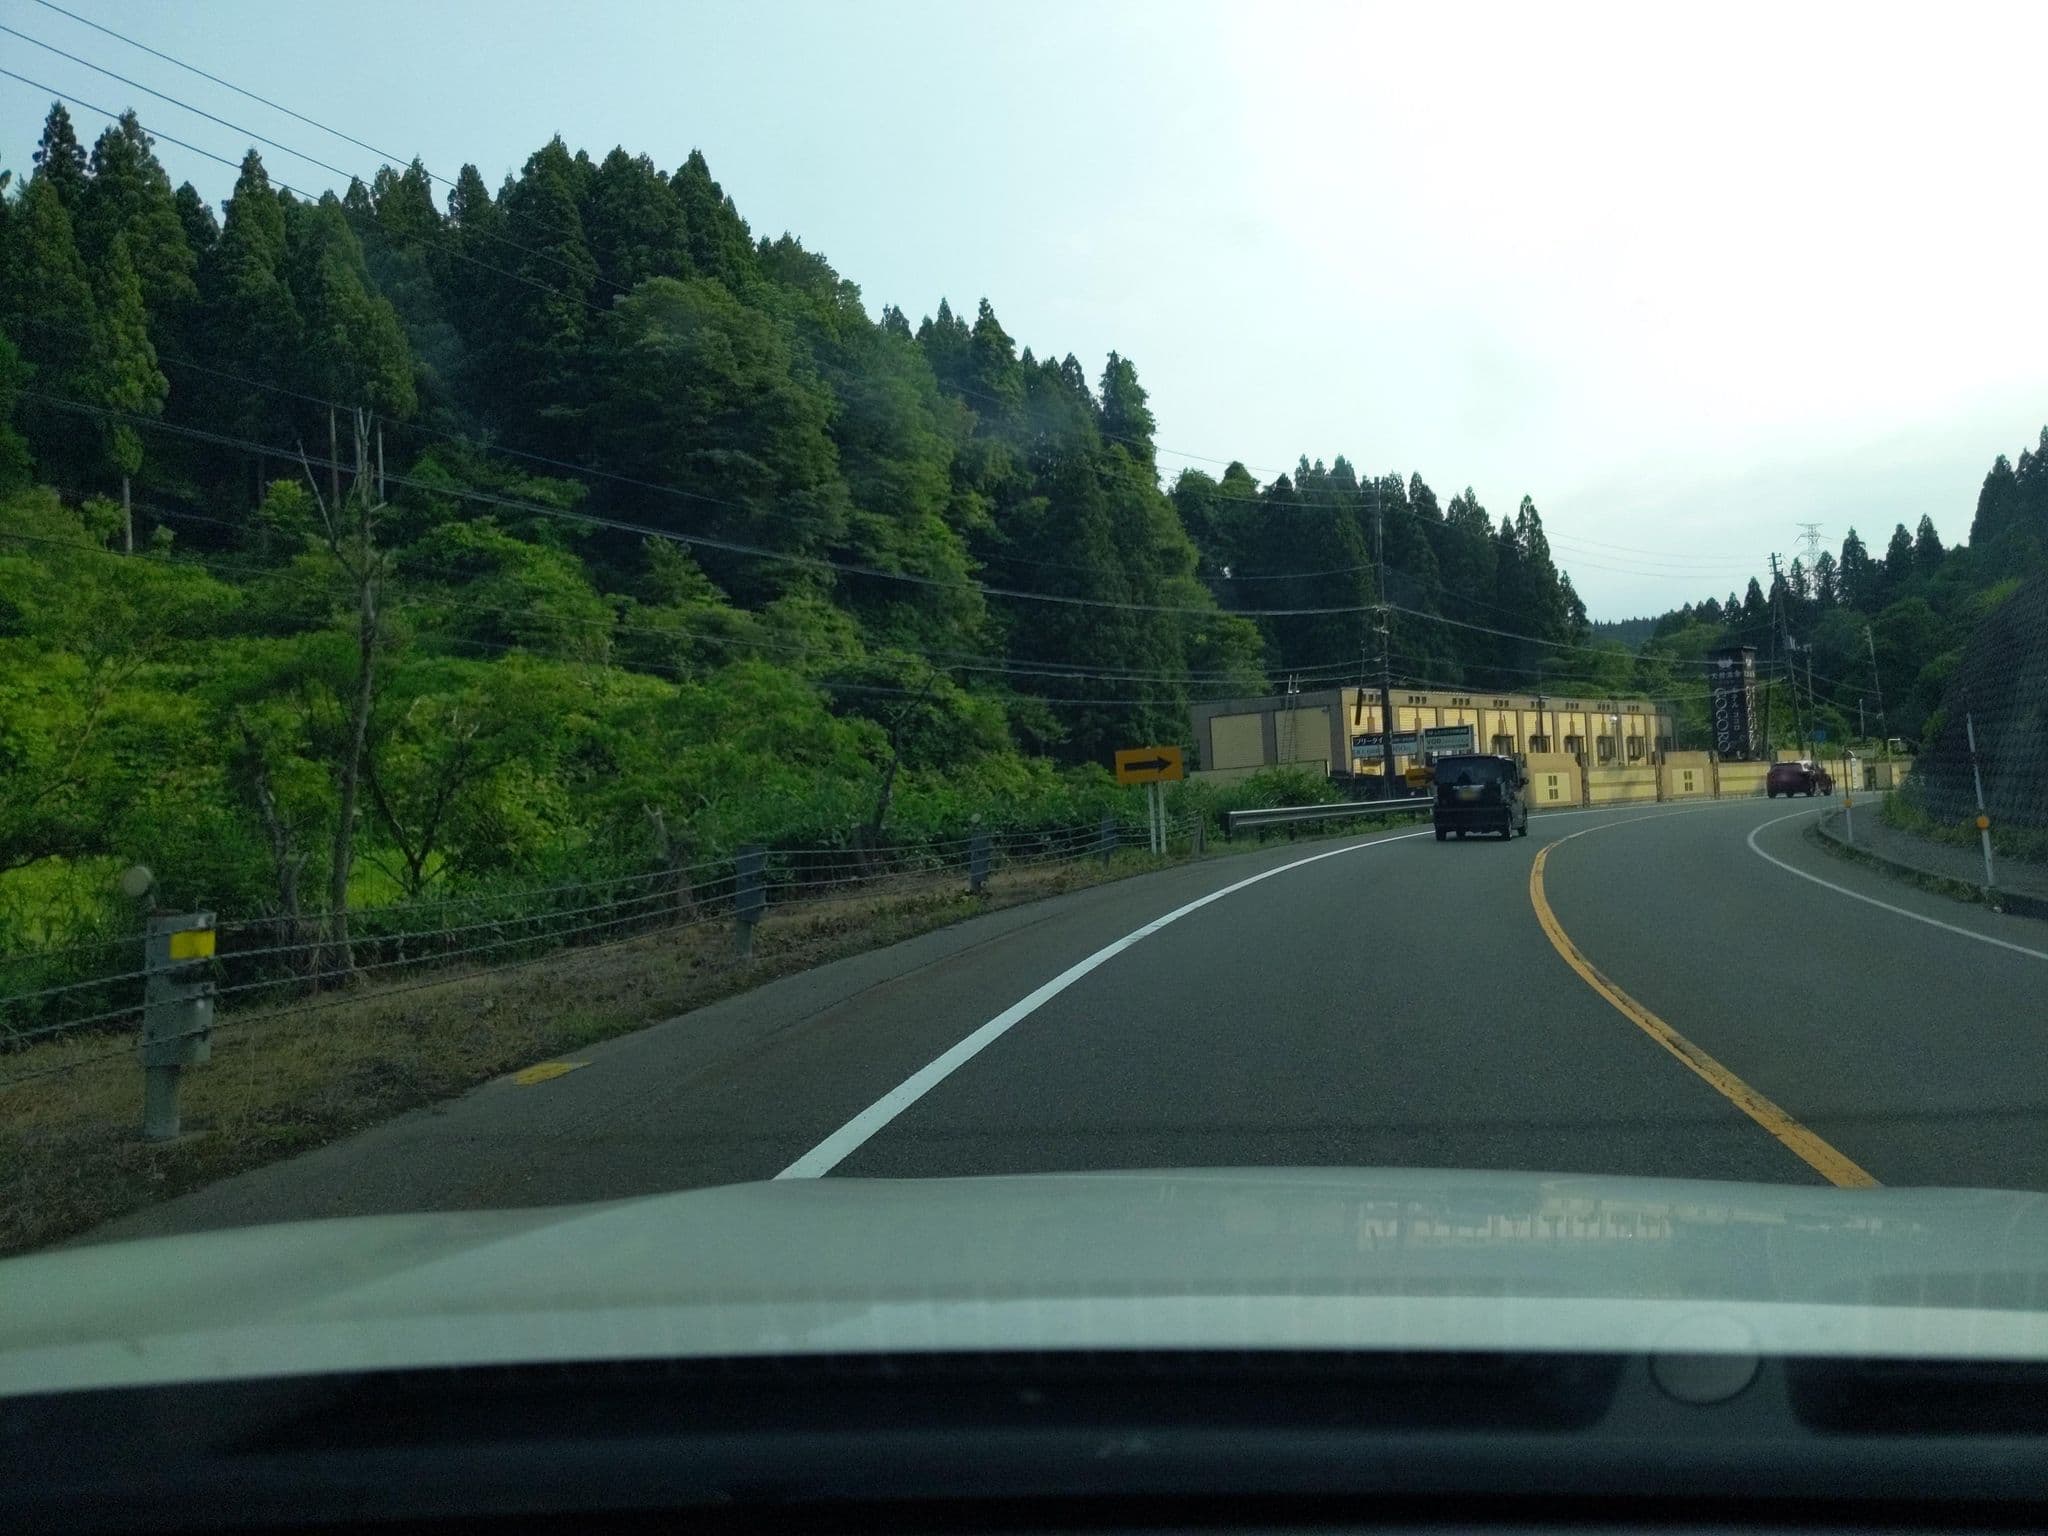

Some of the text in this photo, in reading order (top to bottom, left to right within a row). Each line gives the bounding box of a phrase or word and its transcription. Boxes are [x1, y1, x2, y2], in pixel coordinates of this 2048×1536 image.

[1355, 736, 1383, 745] フリータイ
